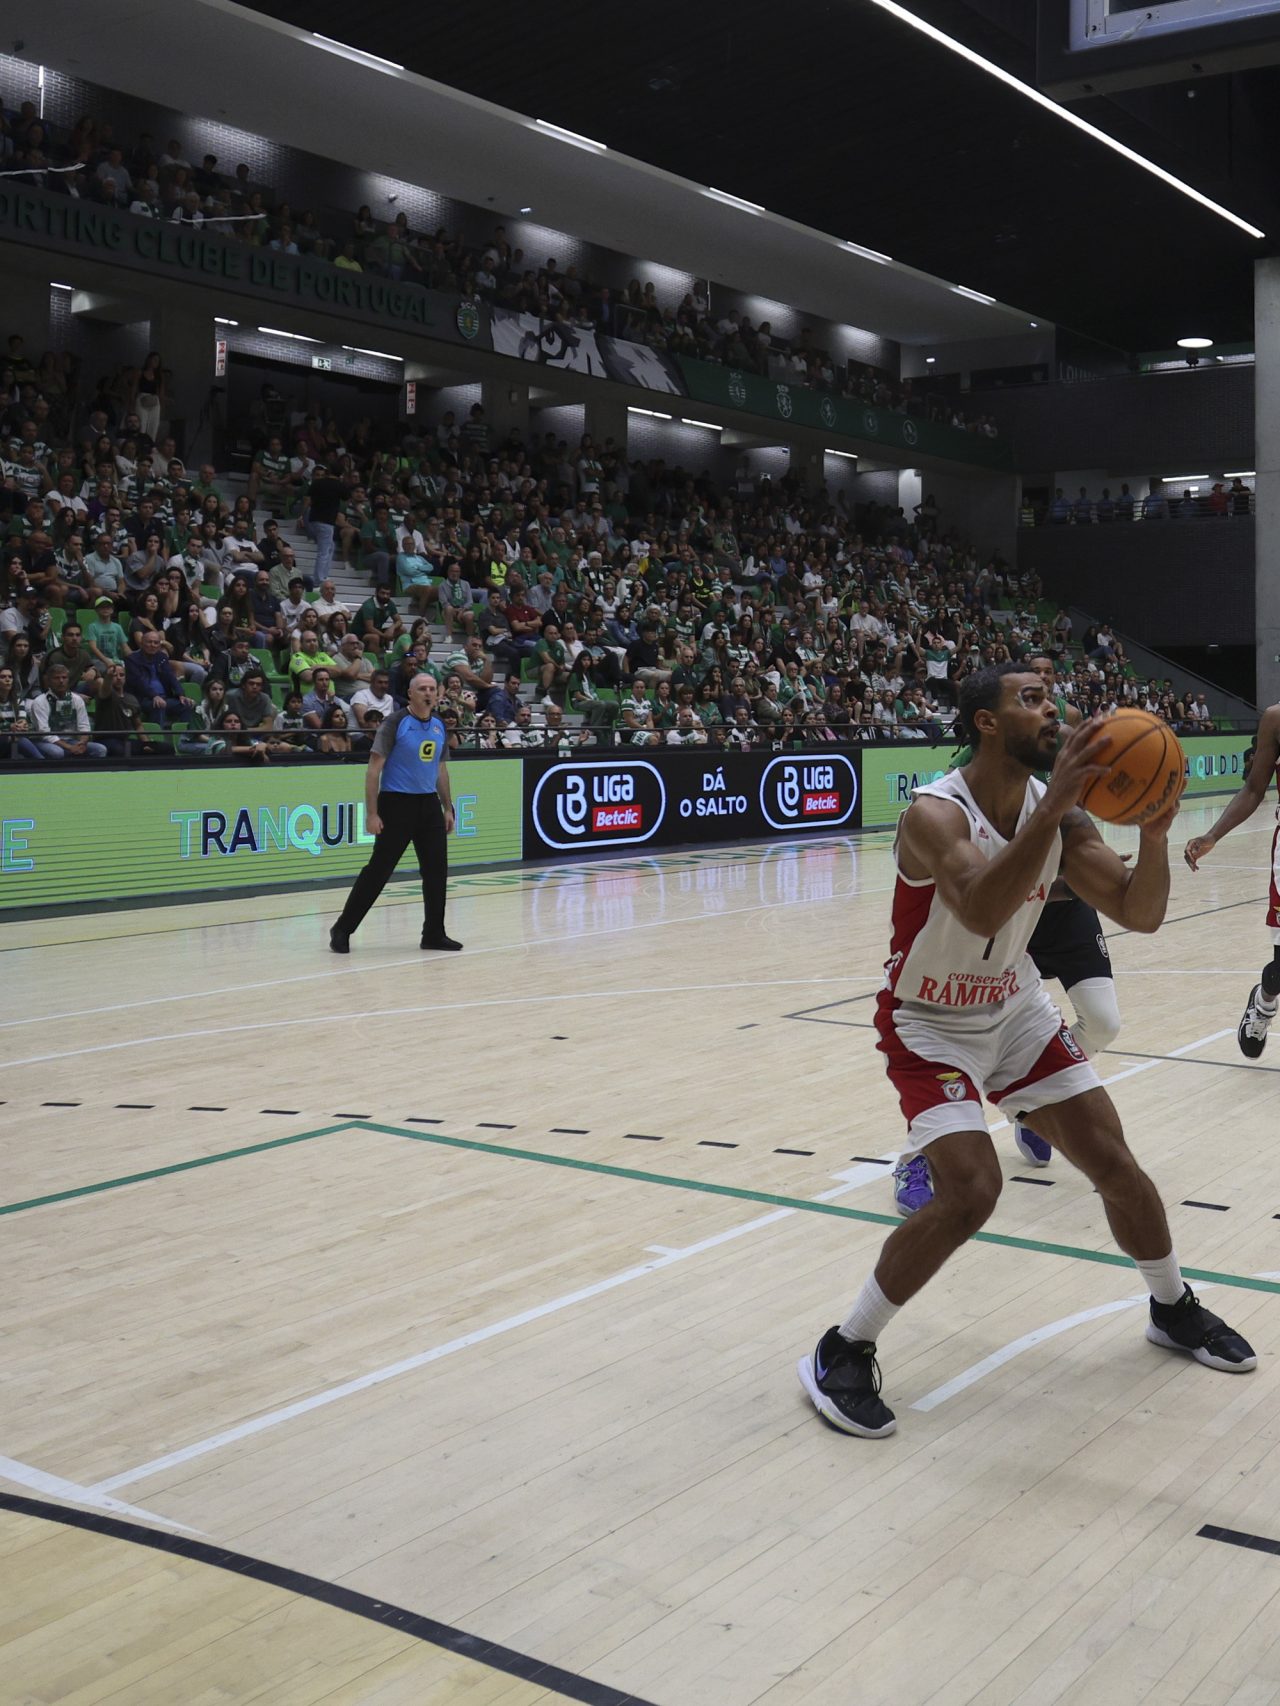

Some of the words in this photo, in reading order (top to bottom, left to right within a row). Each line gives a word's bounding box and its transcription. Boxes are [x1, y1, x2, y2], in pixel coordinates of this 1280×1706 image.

[135, 227, 240, 280] CLUBE
[250, 253, 290, 292] DE
[297, 266, 436, 326] PORTUGAL
[702, 767, 725, 792] DÁ
[680, 800, 692, 817] O
[696, 788, 747, 816] SALTO
[805, 796, 837, 811] Betclic
[596, 810, 638, 828] Betclic
